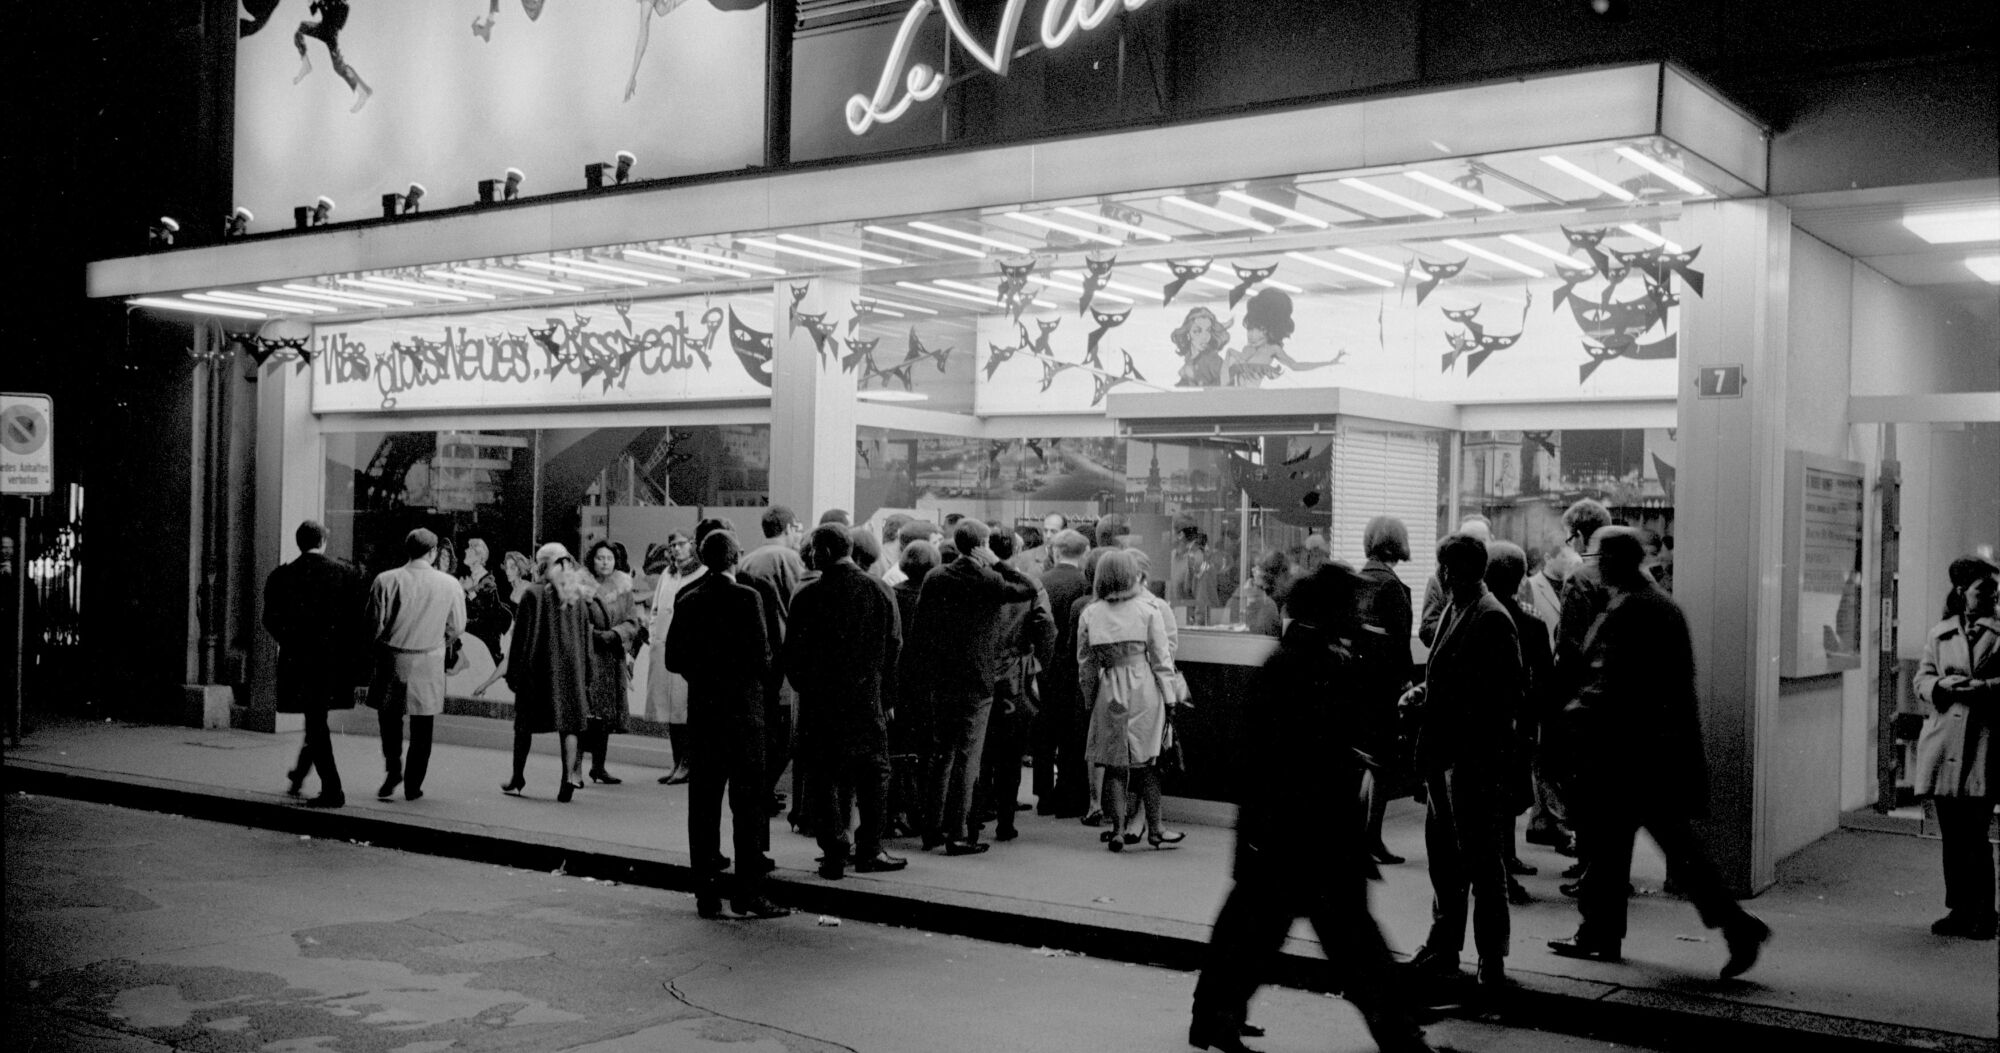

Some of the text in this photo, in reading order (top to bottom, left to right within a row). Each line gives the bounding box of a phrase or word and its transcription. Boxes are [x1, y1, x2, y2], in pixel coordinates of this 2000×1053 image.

[845, 0, 944, 134] Le
[321, 332, 370, 384] Was
[1714, 369, 1725, 393] 7
[0, 463, 17, 473] edes
